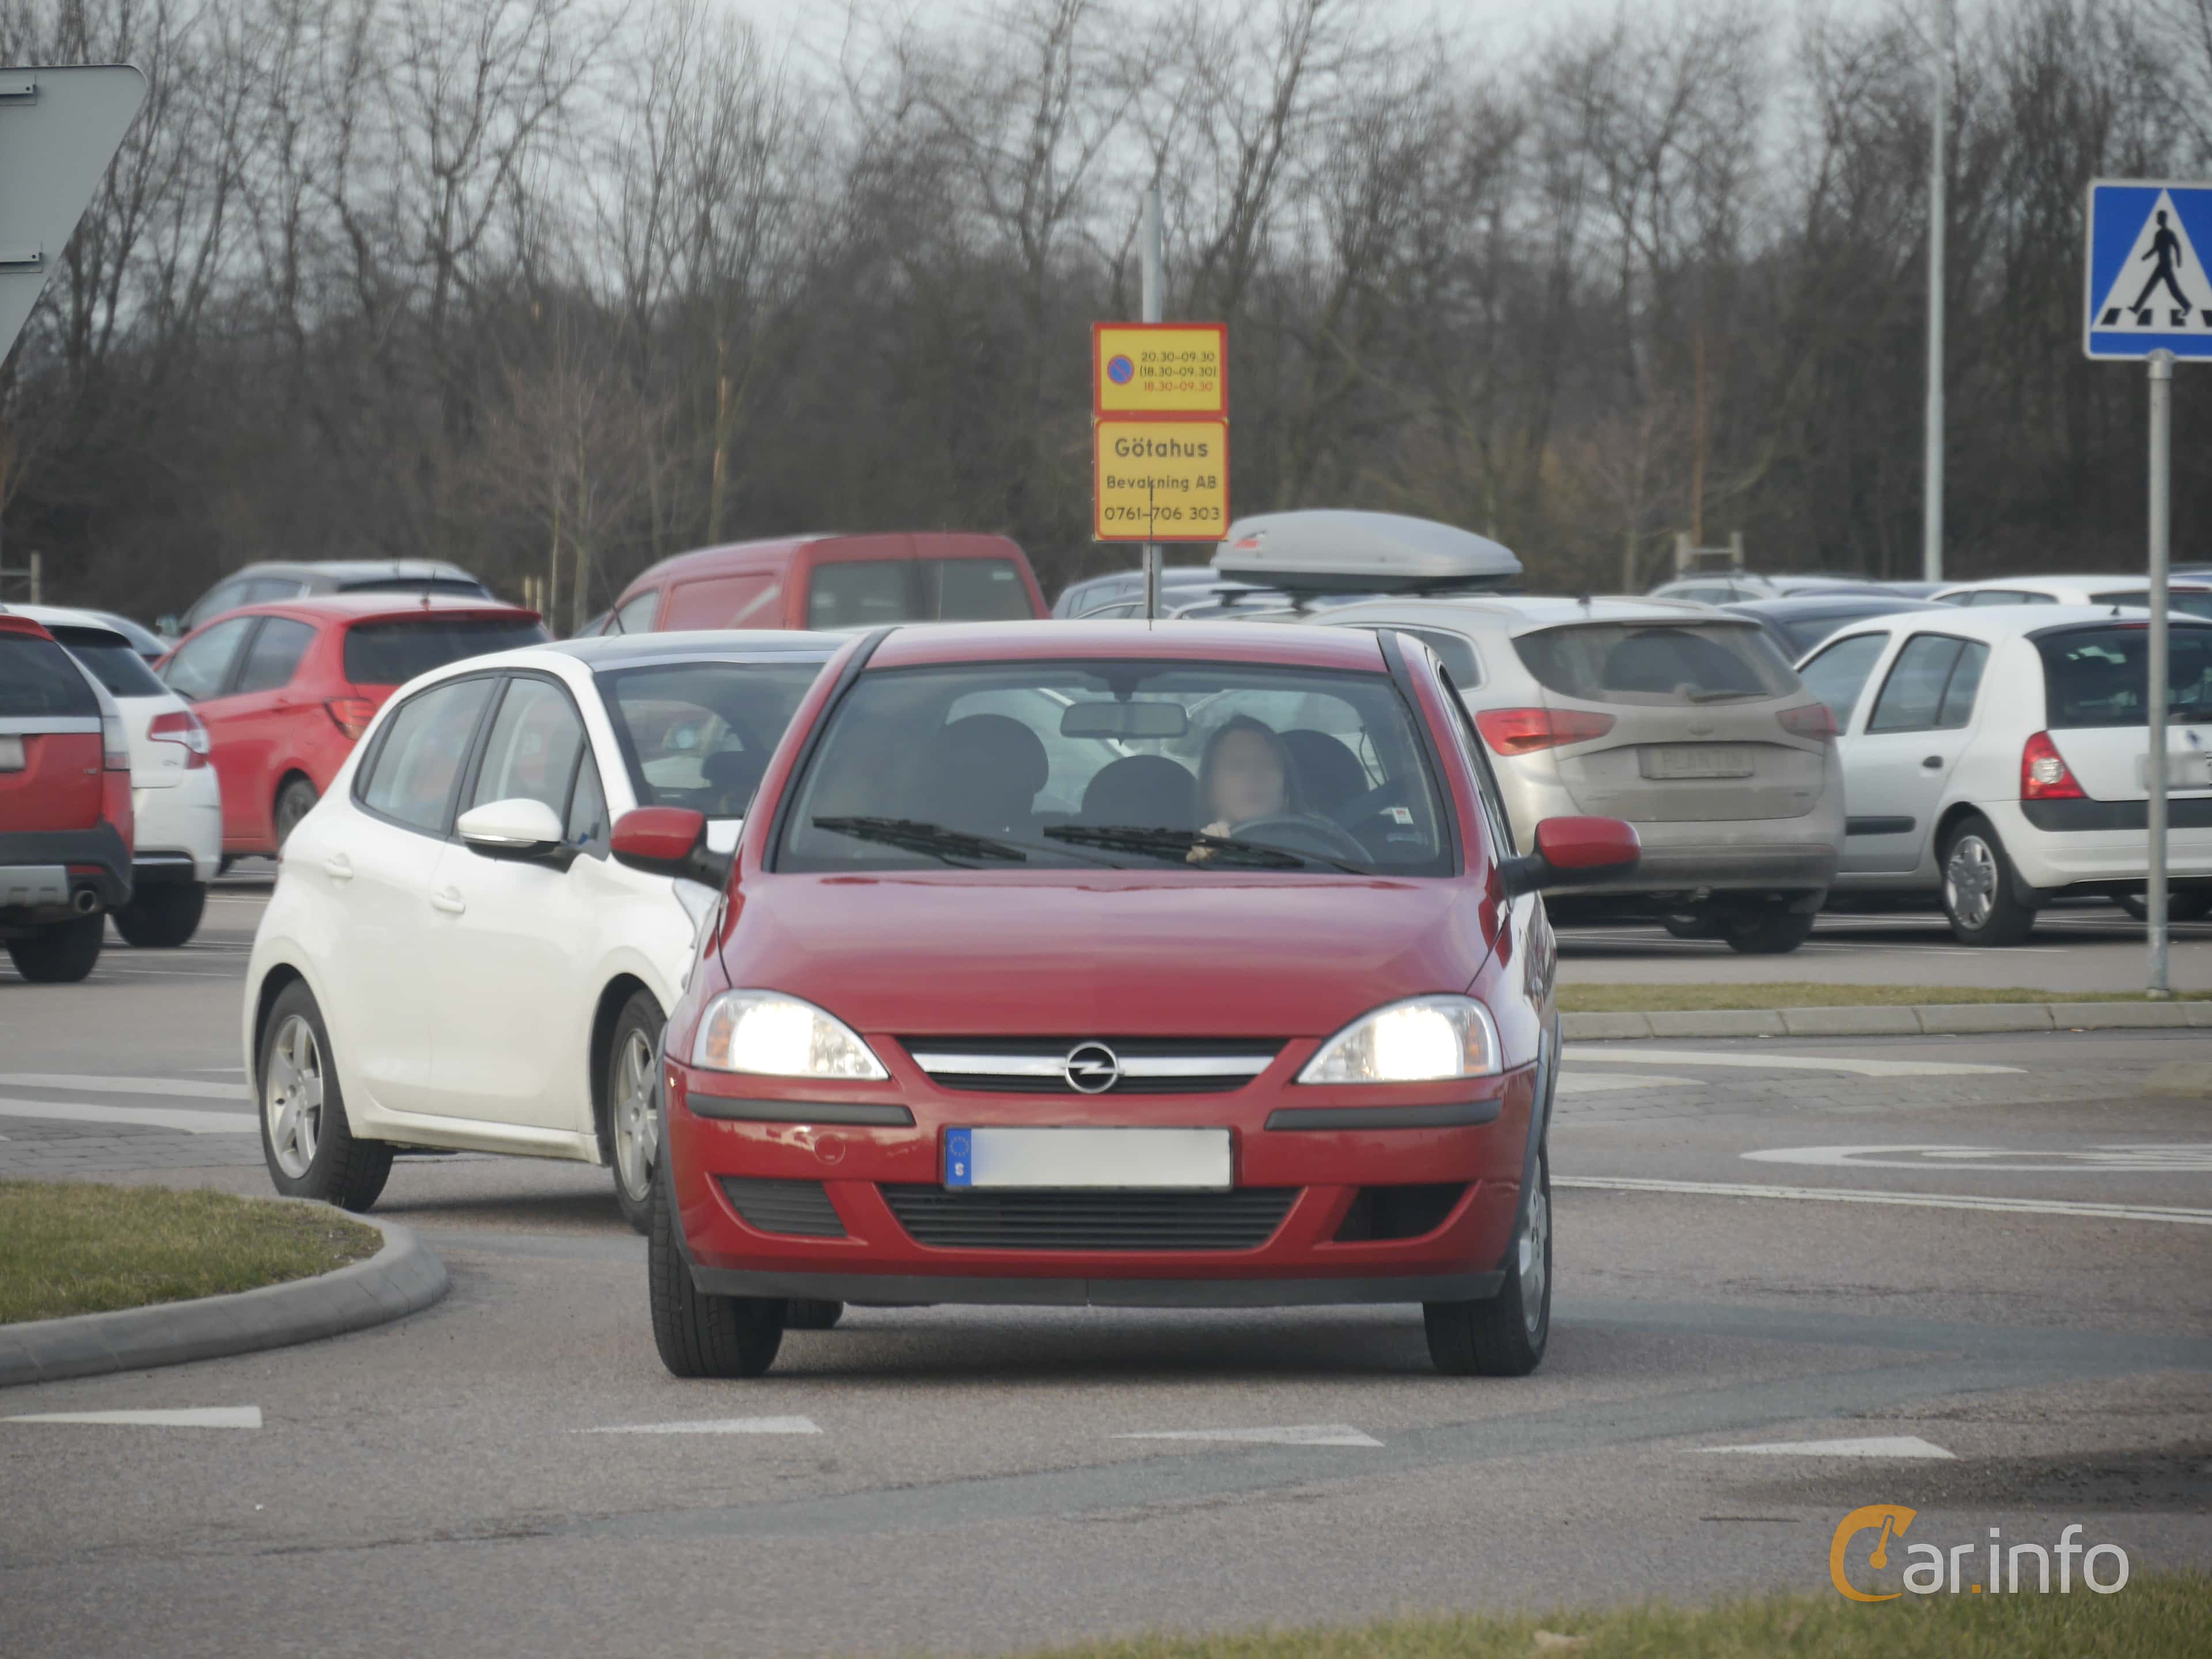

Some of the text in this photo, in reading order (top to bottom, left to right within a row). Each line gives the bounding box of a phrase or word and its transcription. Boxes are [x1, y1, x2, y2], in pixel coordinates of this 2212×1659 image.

[1115, 437, 1209, 458] Götahus
[1107, 475, 1216, 492] Bevakning AB
[1104, 507, 1219, 521] 0761-706 303
